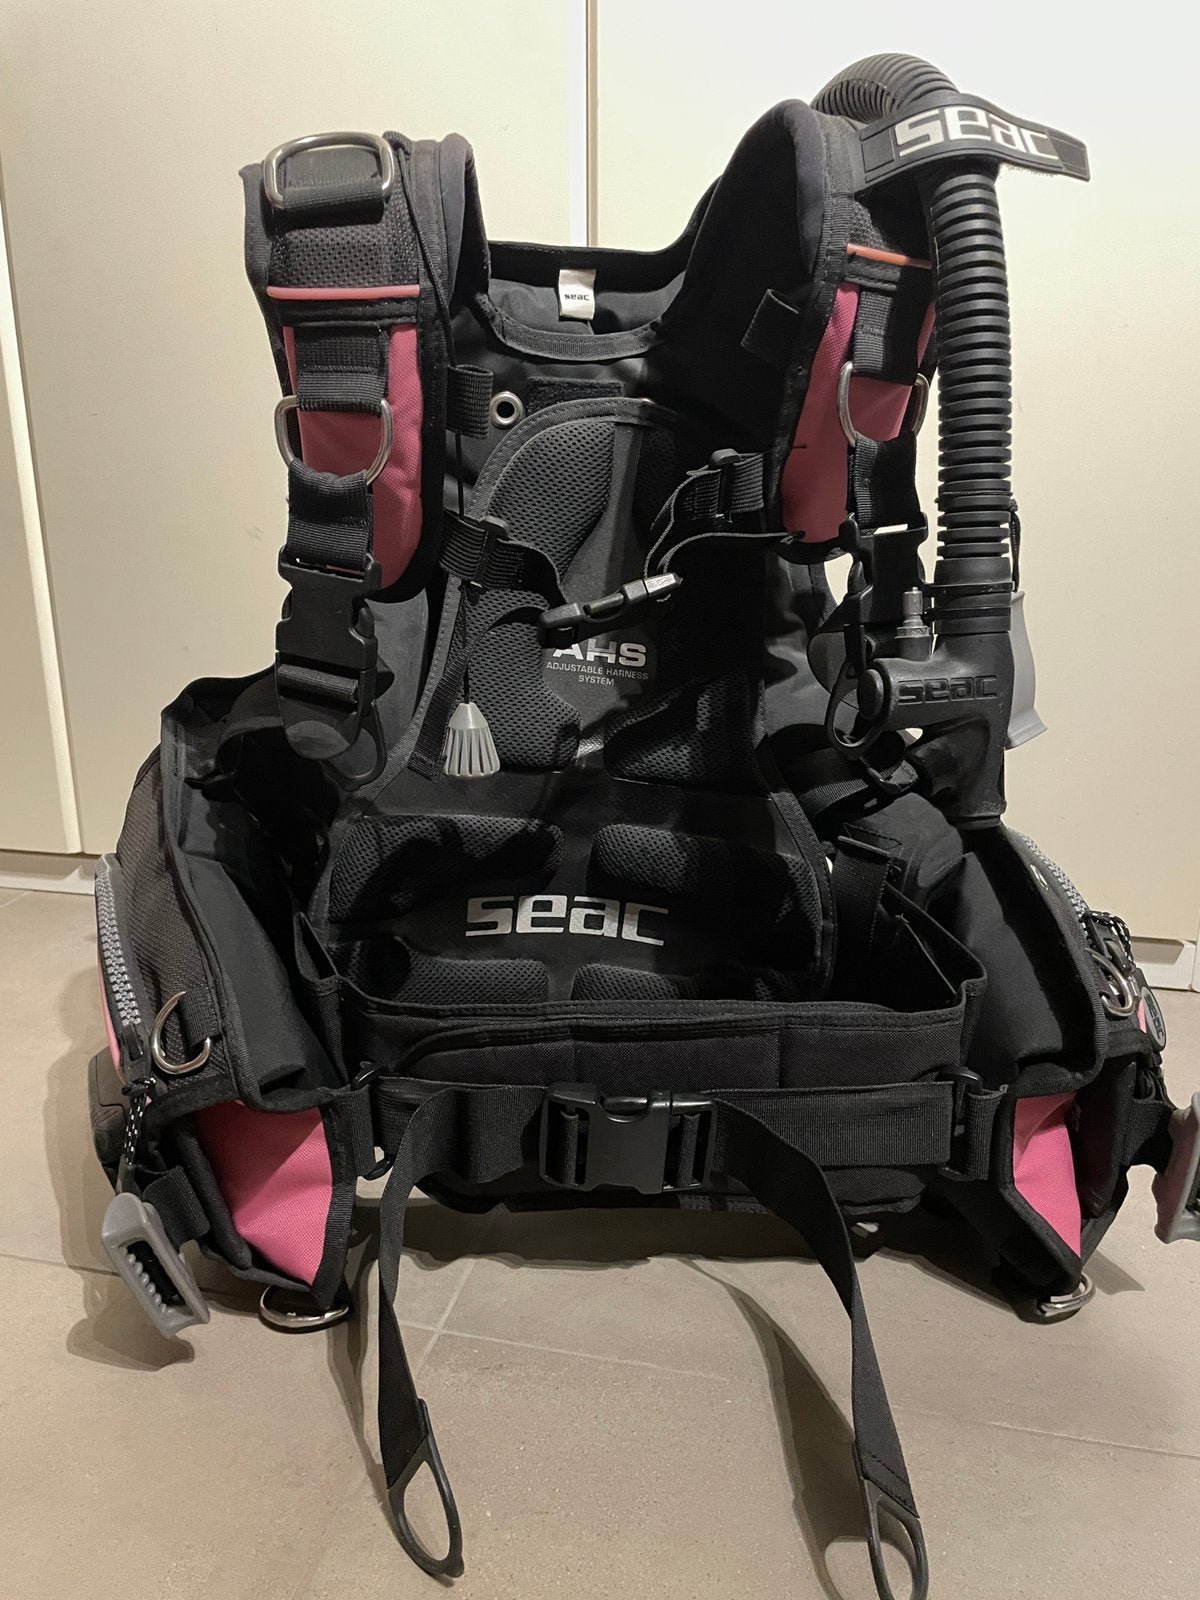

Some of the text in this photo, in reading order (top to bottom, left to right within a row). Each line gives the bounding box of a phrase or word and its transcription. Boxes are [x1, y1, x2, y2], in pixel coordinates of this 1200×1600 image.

[895, 105, 1059, 160] seac
[546, 661, 649, 680] ADJUSTABLE HARNESS
[578, 674, 615, 686] SYSTEM
[898, 675, 997, 705] seac
[465, 894, 669, 946] seac
